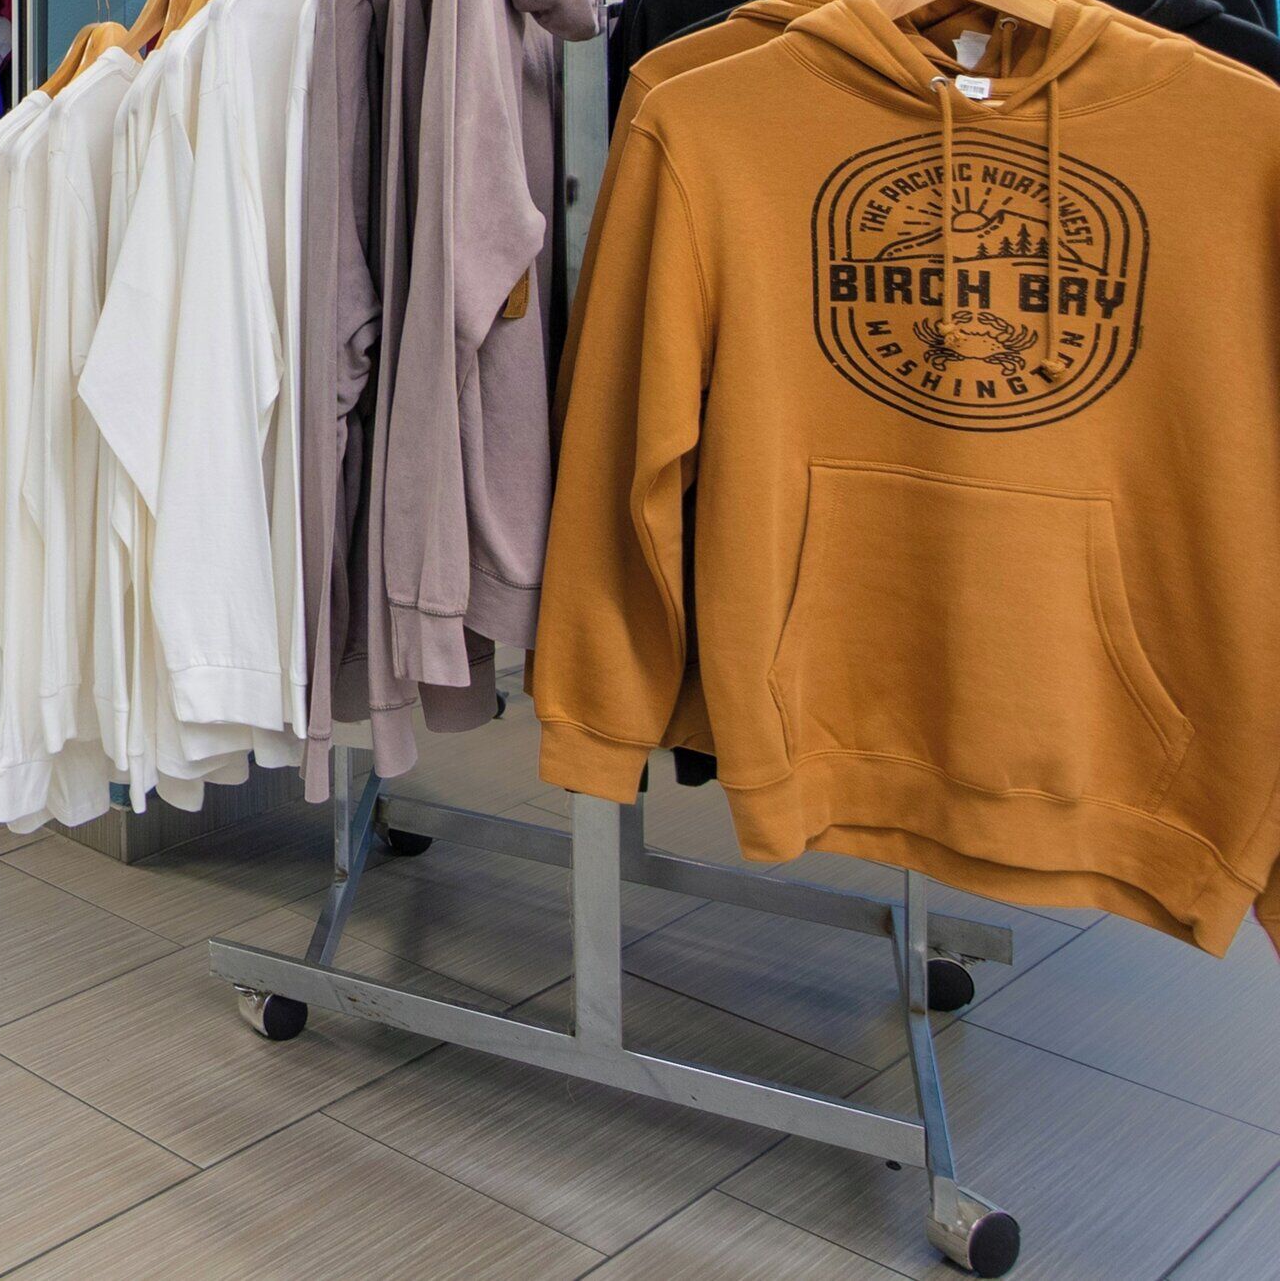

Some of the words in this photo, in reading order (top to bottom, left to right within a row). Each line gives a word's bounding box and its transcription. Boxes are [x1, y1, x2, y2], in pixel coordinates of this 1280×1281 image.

[859, 199, 894, 233] THE
[830, 264, 991, 309] BIRCH
[1019, 273, 1126, 319] BAY
